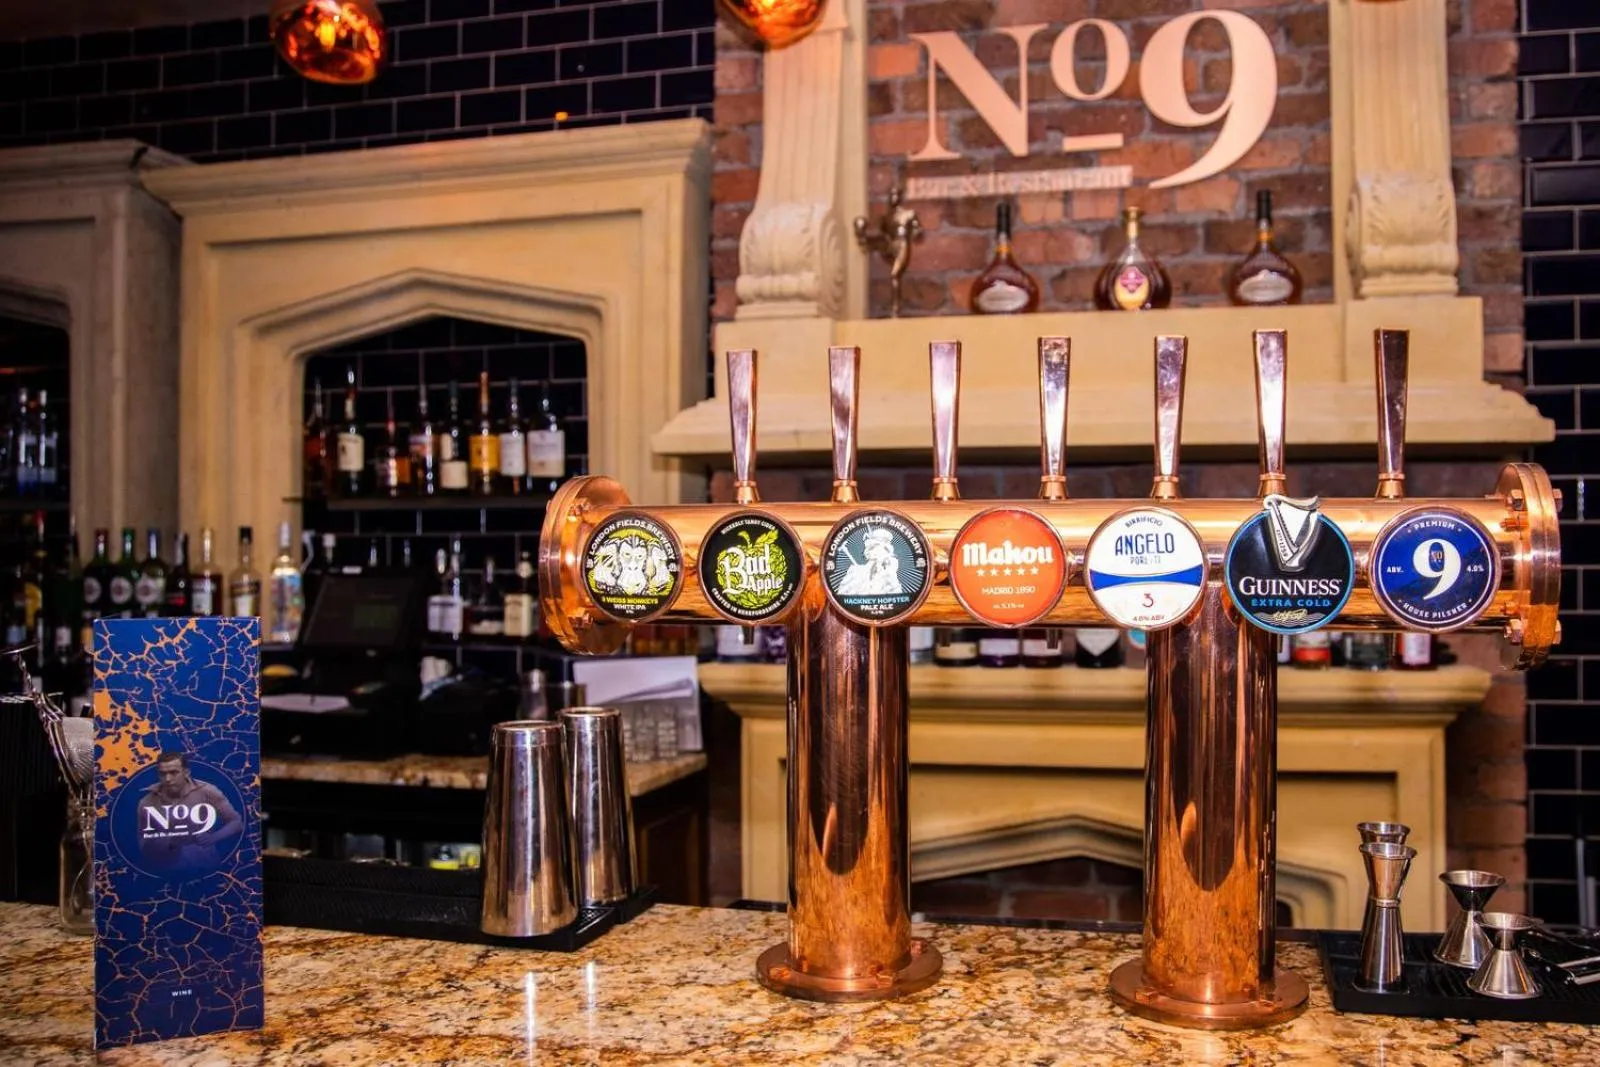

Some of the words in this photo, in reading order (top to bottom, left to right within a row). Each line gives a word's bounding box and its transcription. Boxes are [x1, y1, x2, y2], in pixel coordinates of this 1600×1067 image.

[1413, 520, 1456, 531] PREMIUM
[589, 523, 617, 556] LONDON
[616, 518, 646, 530] FIELDS
[646, 524, 676, 560] BREWERY
[828, 522, 856, 557] LONDON
[855, 515, 888, 527] FIELDS
[889, 518, 924, 555] BREWERY
[1114, 532, 1176, 556] ANGELO
[962, 540, 1054, 567] Mahou
[720, 543, 773, 594] Bad
[1412, 538, 1462, 600] 9
[747, 573, 784, 596] Apple
[981, 586, 1014, 595] MADRID
[1239, 576, 1341, 596] GUINNESS
[843, 597, 877, 605] HACKNEY
[1141, 592, 1154, 608] 3
[1251, 598, 1292, 607] EXTRA
[1296, 598, 1332, 607] COLD
[1402, 602, 1430, 619] HOUSE
[1431, 602, 1469, 619] PILSNER
[171, 988, 193, 997] WINE
